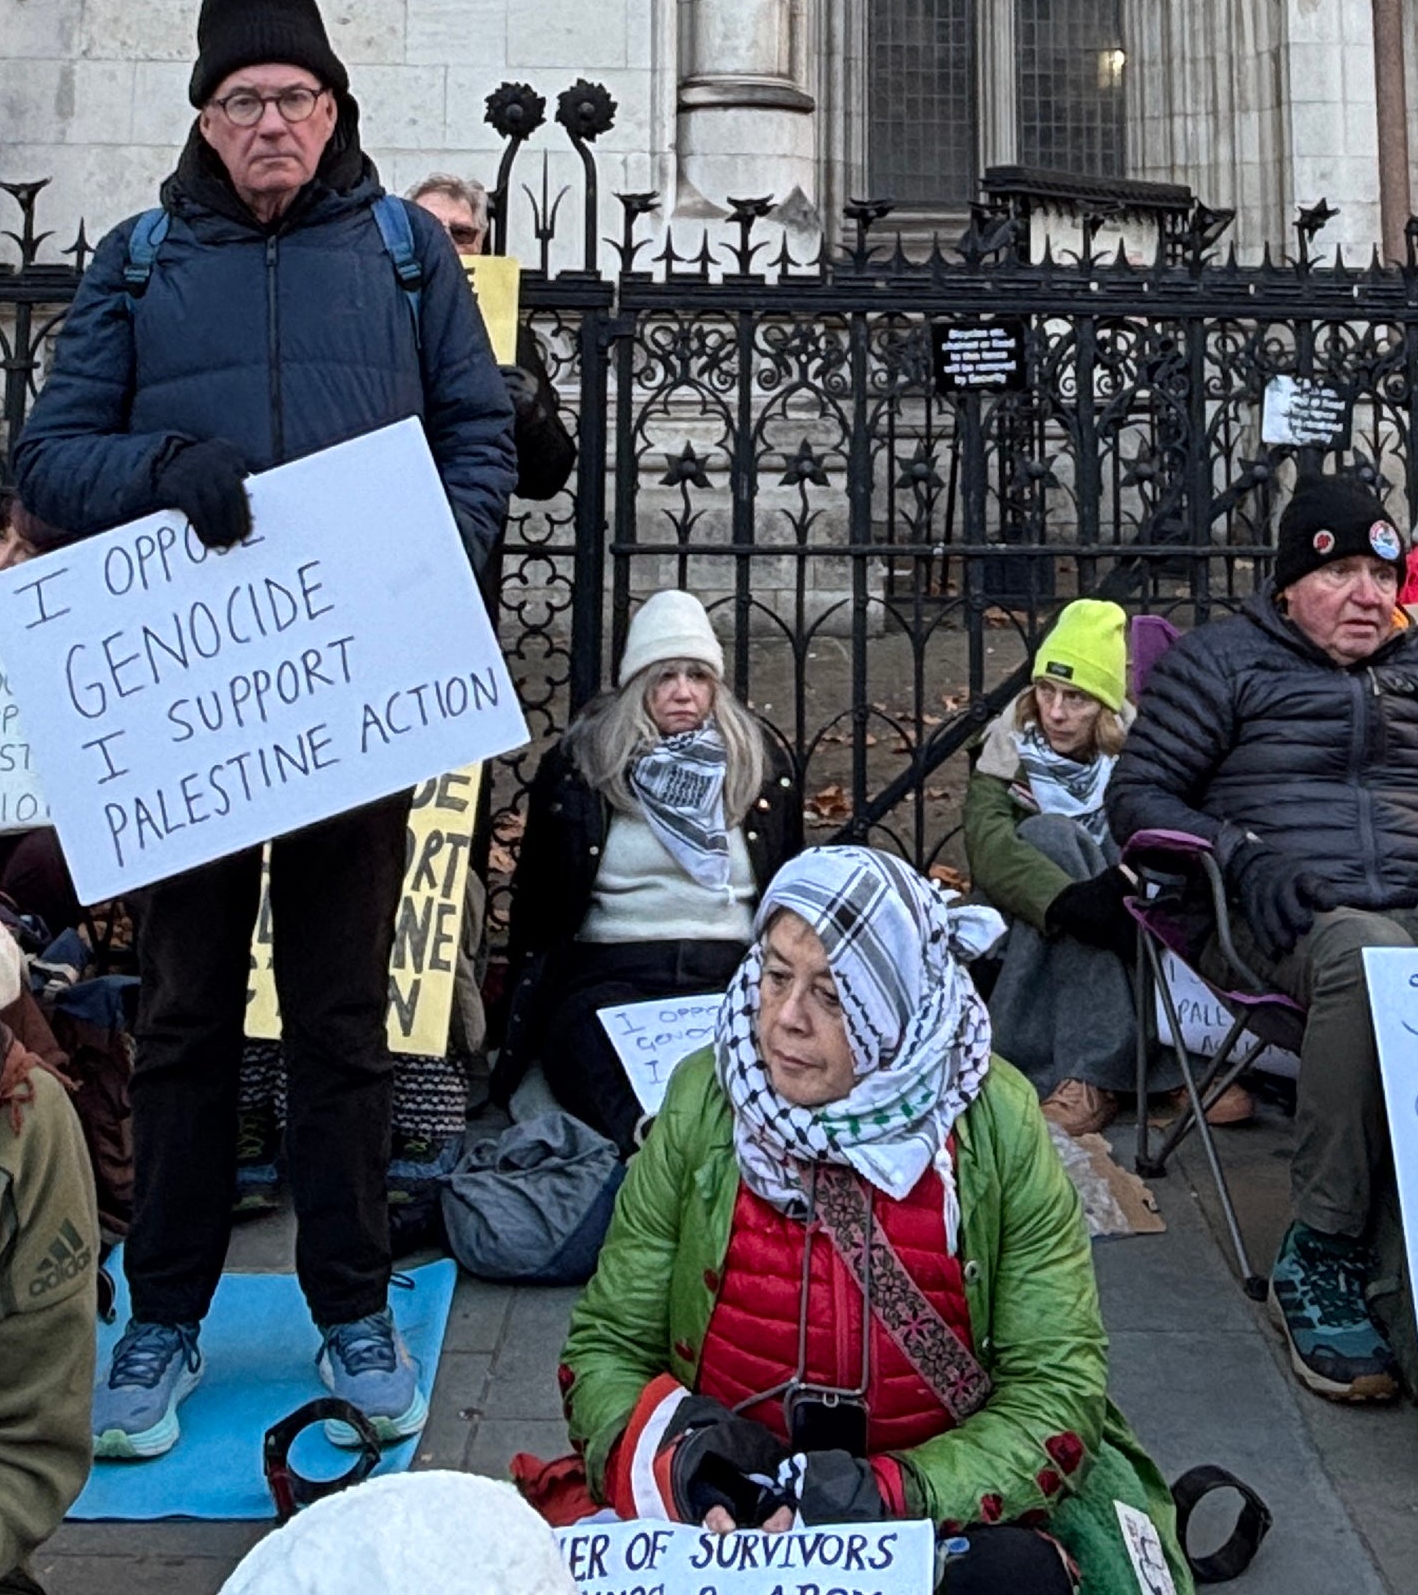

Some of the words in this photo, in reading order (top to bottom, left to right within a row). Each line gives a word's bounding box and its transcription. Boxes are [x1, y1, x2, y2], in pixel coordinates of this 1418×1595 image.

[14, 567, 71, 629] I
[65, 559, 335, 720] GENOCIDE
[81, 730, 130, 784] I
[167, 636, 355, 743] SUPPORT
[105, 722, 342, 867] PALESTINE
[360, 666, 500, 754] ACTION
[1178, 999, 1227, 1027] PALE
[626, 1530, 674, 1571] OF
[690, 1531, 898, 1572] SURVIVORS
